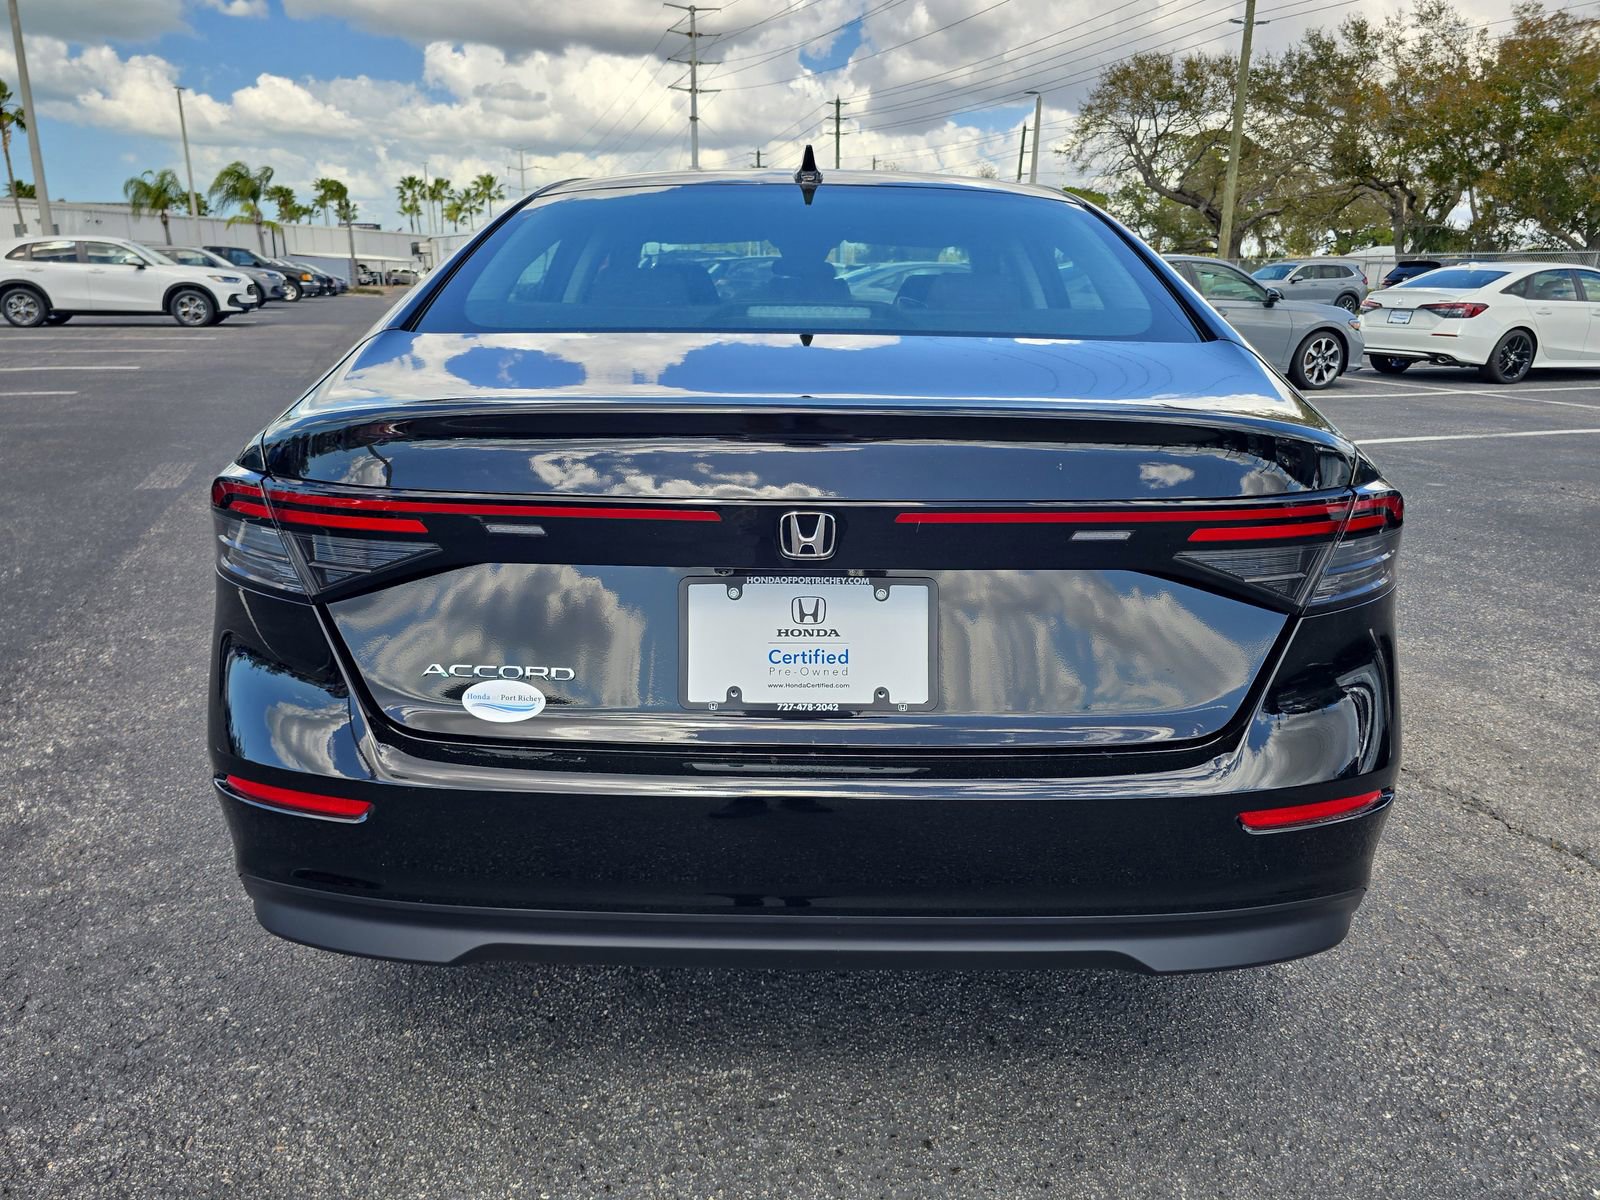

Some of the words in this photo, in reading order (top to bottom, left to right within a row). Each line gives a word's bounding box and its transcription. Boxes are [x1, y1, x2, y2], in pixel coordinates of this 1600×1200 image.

[746, 576, 870, 585] HONDAOFPORTRICHEY.COM
[776, 628, 840, 638] HONDA
[768, 648, 849, 664] Certified
[421, 663, 575, 681] ACCORD
[769, 667, 848, 677] Pre-Owned
[500, 694, 516, 702] Port
[517, 695, 542, 703] Richey
[777, 703, 839, 711] 727-478-2042
